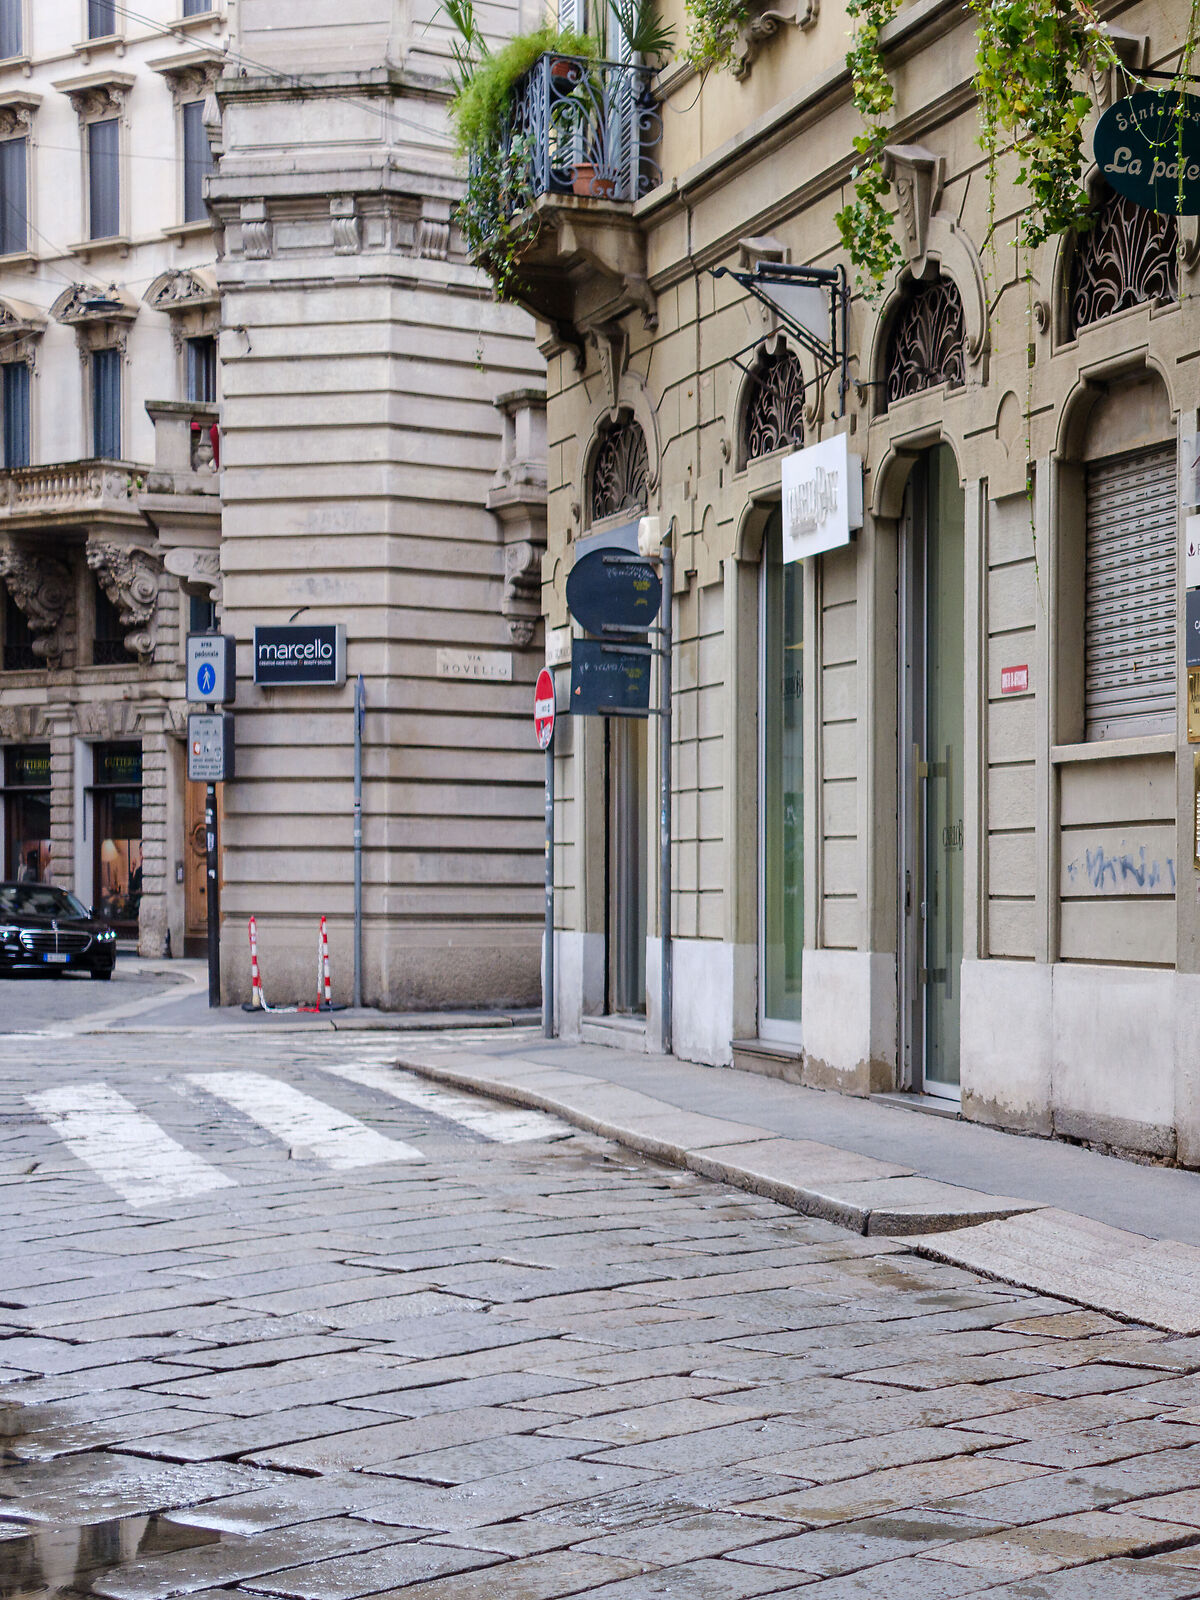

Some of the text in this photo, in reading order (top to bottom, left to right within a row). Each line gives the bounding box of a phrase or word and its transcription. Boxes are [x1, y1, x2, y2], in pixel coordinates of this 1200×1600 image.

[1104, 146, 1142, 175] La
[259, 639, 332, 659] marcello
[443, 664, 507, 676] ROVELLO
